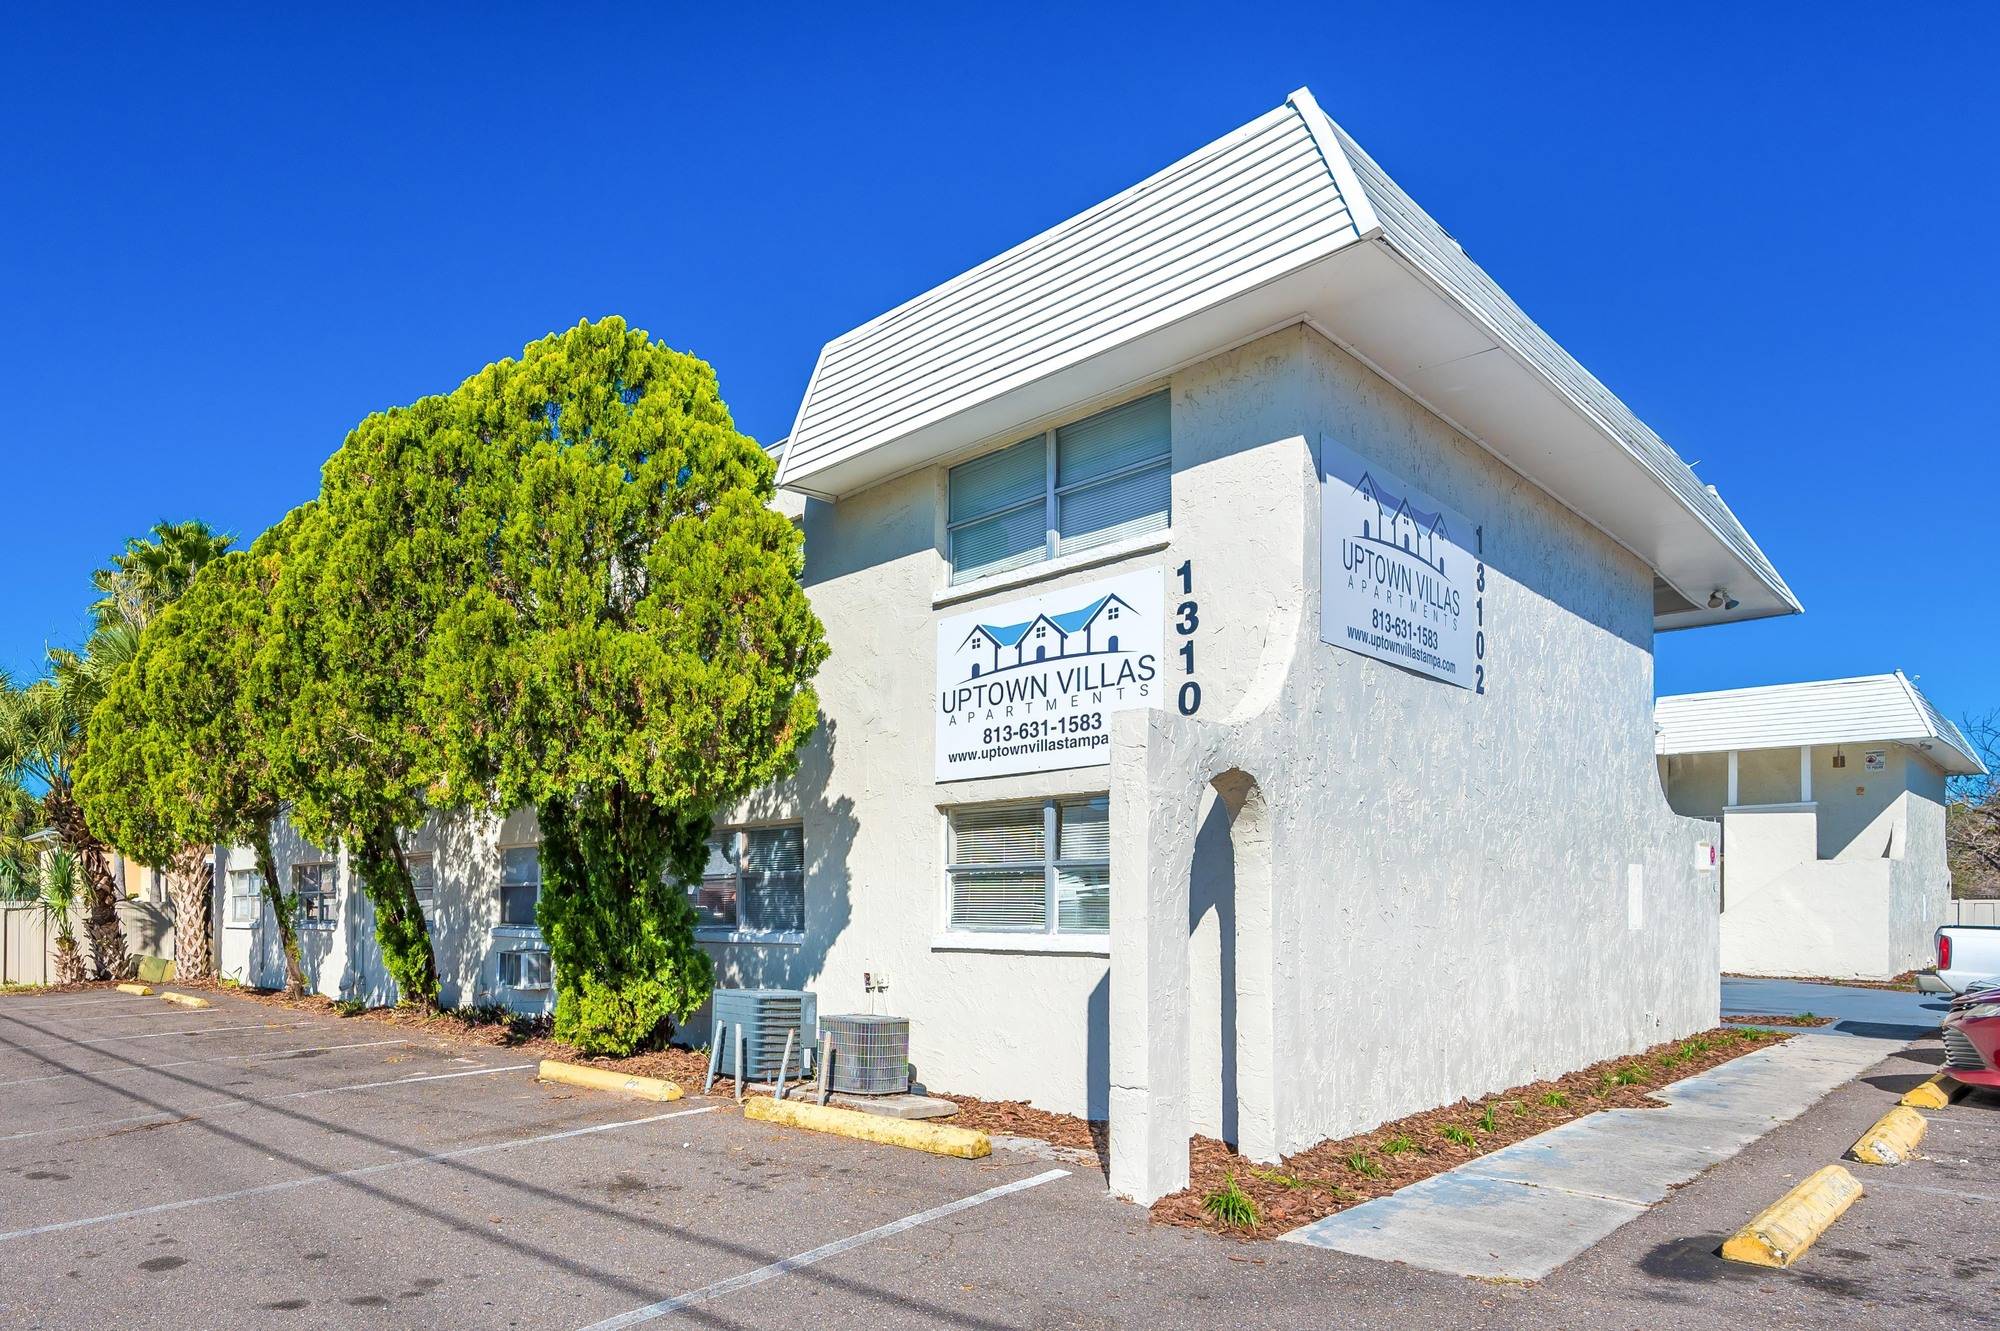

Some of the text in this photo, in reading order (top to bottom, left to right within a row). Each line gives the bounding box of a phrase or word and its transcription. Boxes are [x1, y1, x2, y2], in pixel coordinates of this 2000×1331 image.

[1342, 538, 1460, 617] UPTOWN VILLAS
[1347, 575, 1458, 632] APARTMENTS
[1176, 559, 1202, 717] 1310
[1372, 608, 1439, 650] 813-631-1583
[1475, 526, 1485, 694] 13102
[1347, 625, 1456, 674] www.uptownvillastampa.com
[942, 654, 1156, 714] UPTOWN VILLAS
[949, 683, 1149, 726] APARTMENTS
[982, 712, 1102, 745] 813-631-1583
